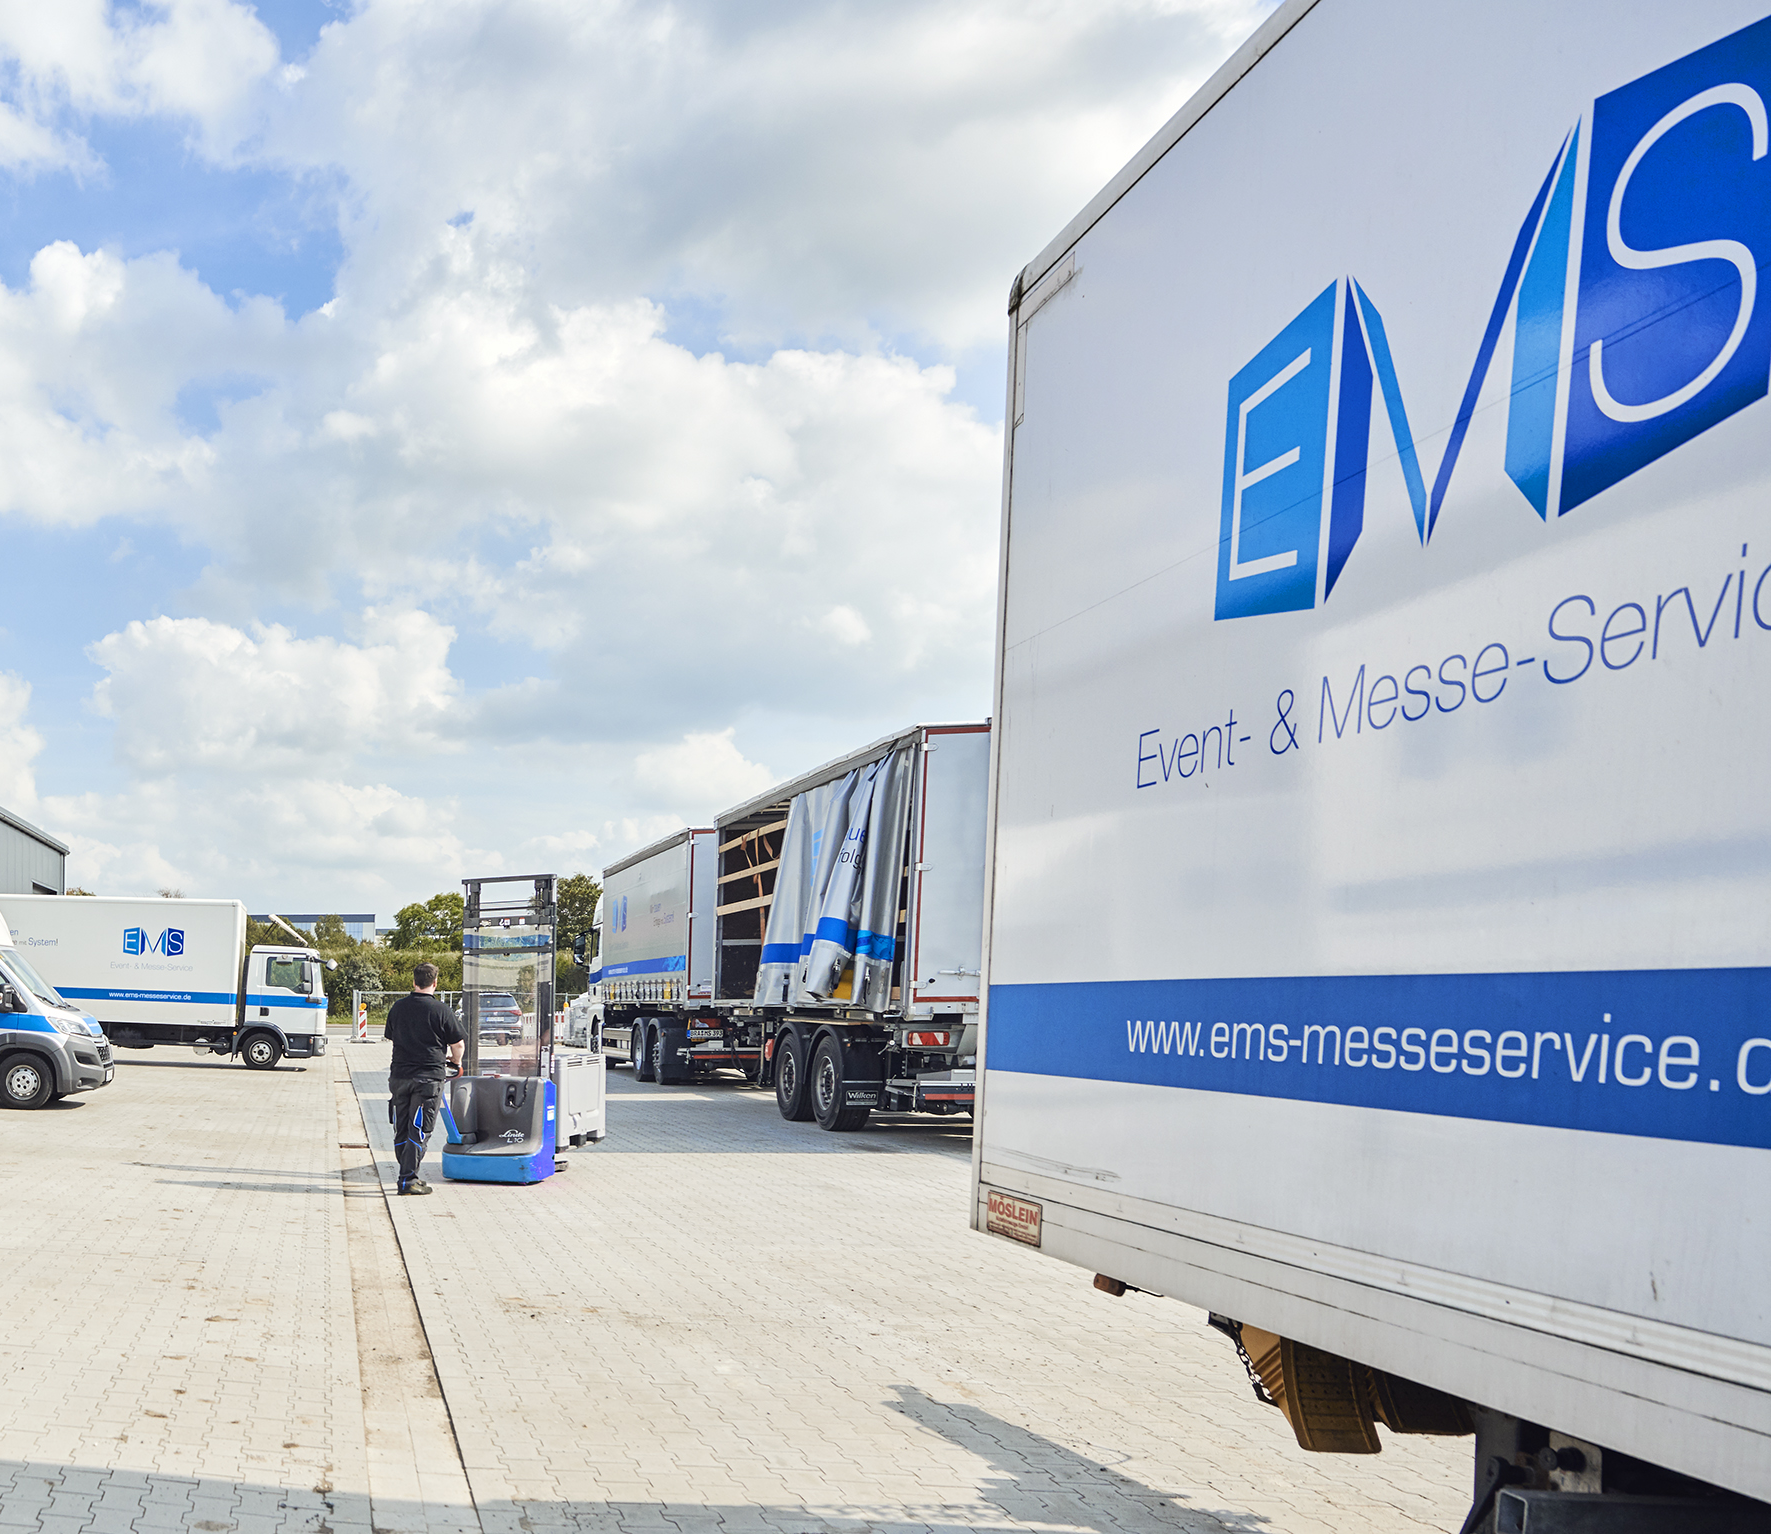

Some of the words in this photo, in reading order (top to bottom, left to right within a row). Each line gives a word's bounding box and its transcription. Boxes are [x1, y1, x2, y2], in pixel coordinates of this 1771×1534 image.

[1214, 60, 1771, 620] EMS
[1136, 708, 1252, 790] Event-
[1269, 689, 1300, 755] &
[28, 936, 59, 948] System!
[122, 926, 185, 957] EMS
[110, 961, 132, 970] Event-
[134, 962, 140, 970] &
[141, 963, 194, 972] Messe-Service
[108, 992, 192, 1001] www.ems-messeservice.de
[848, 1091, 877, 1099] Wilken
[498, 1128, 525, 1138] Linde
